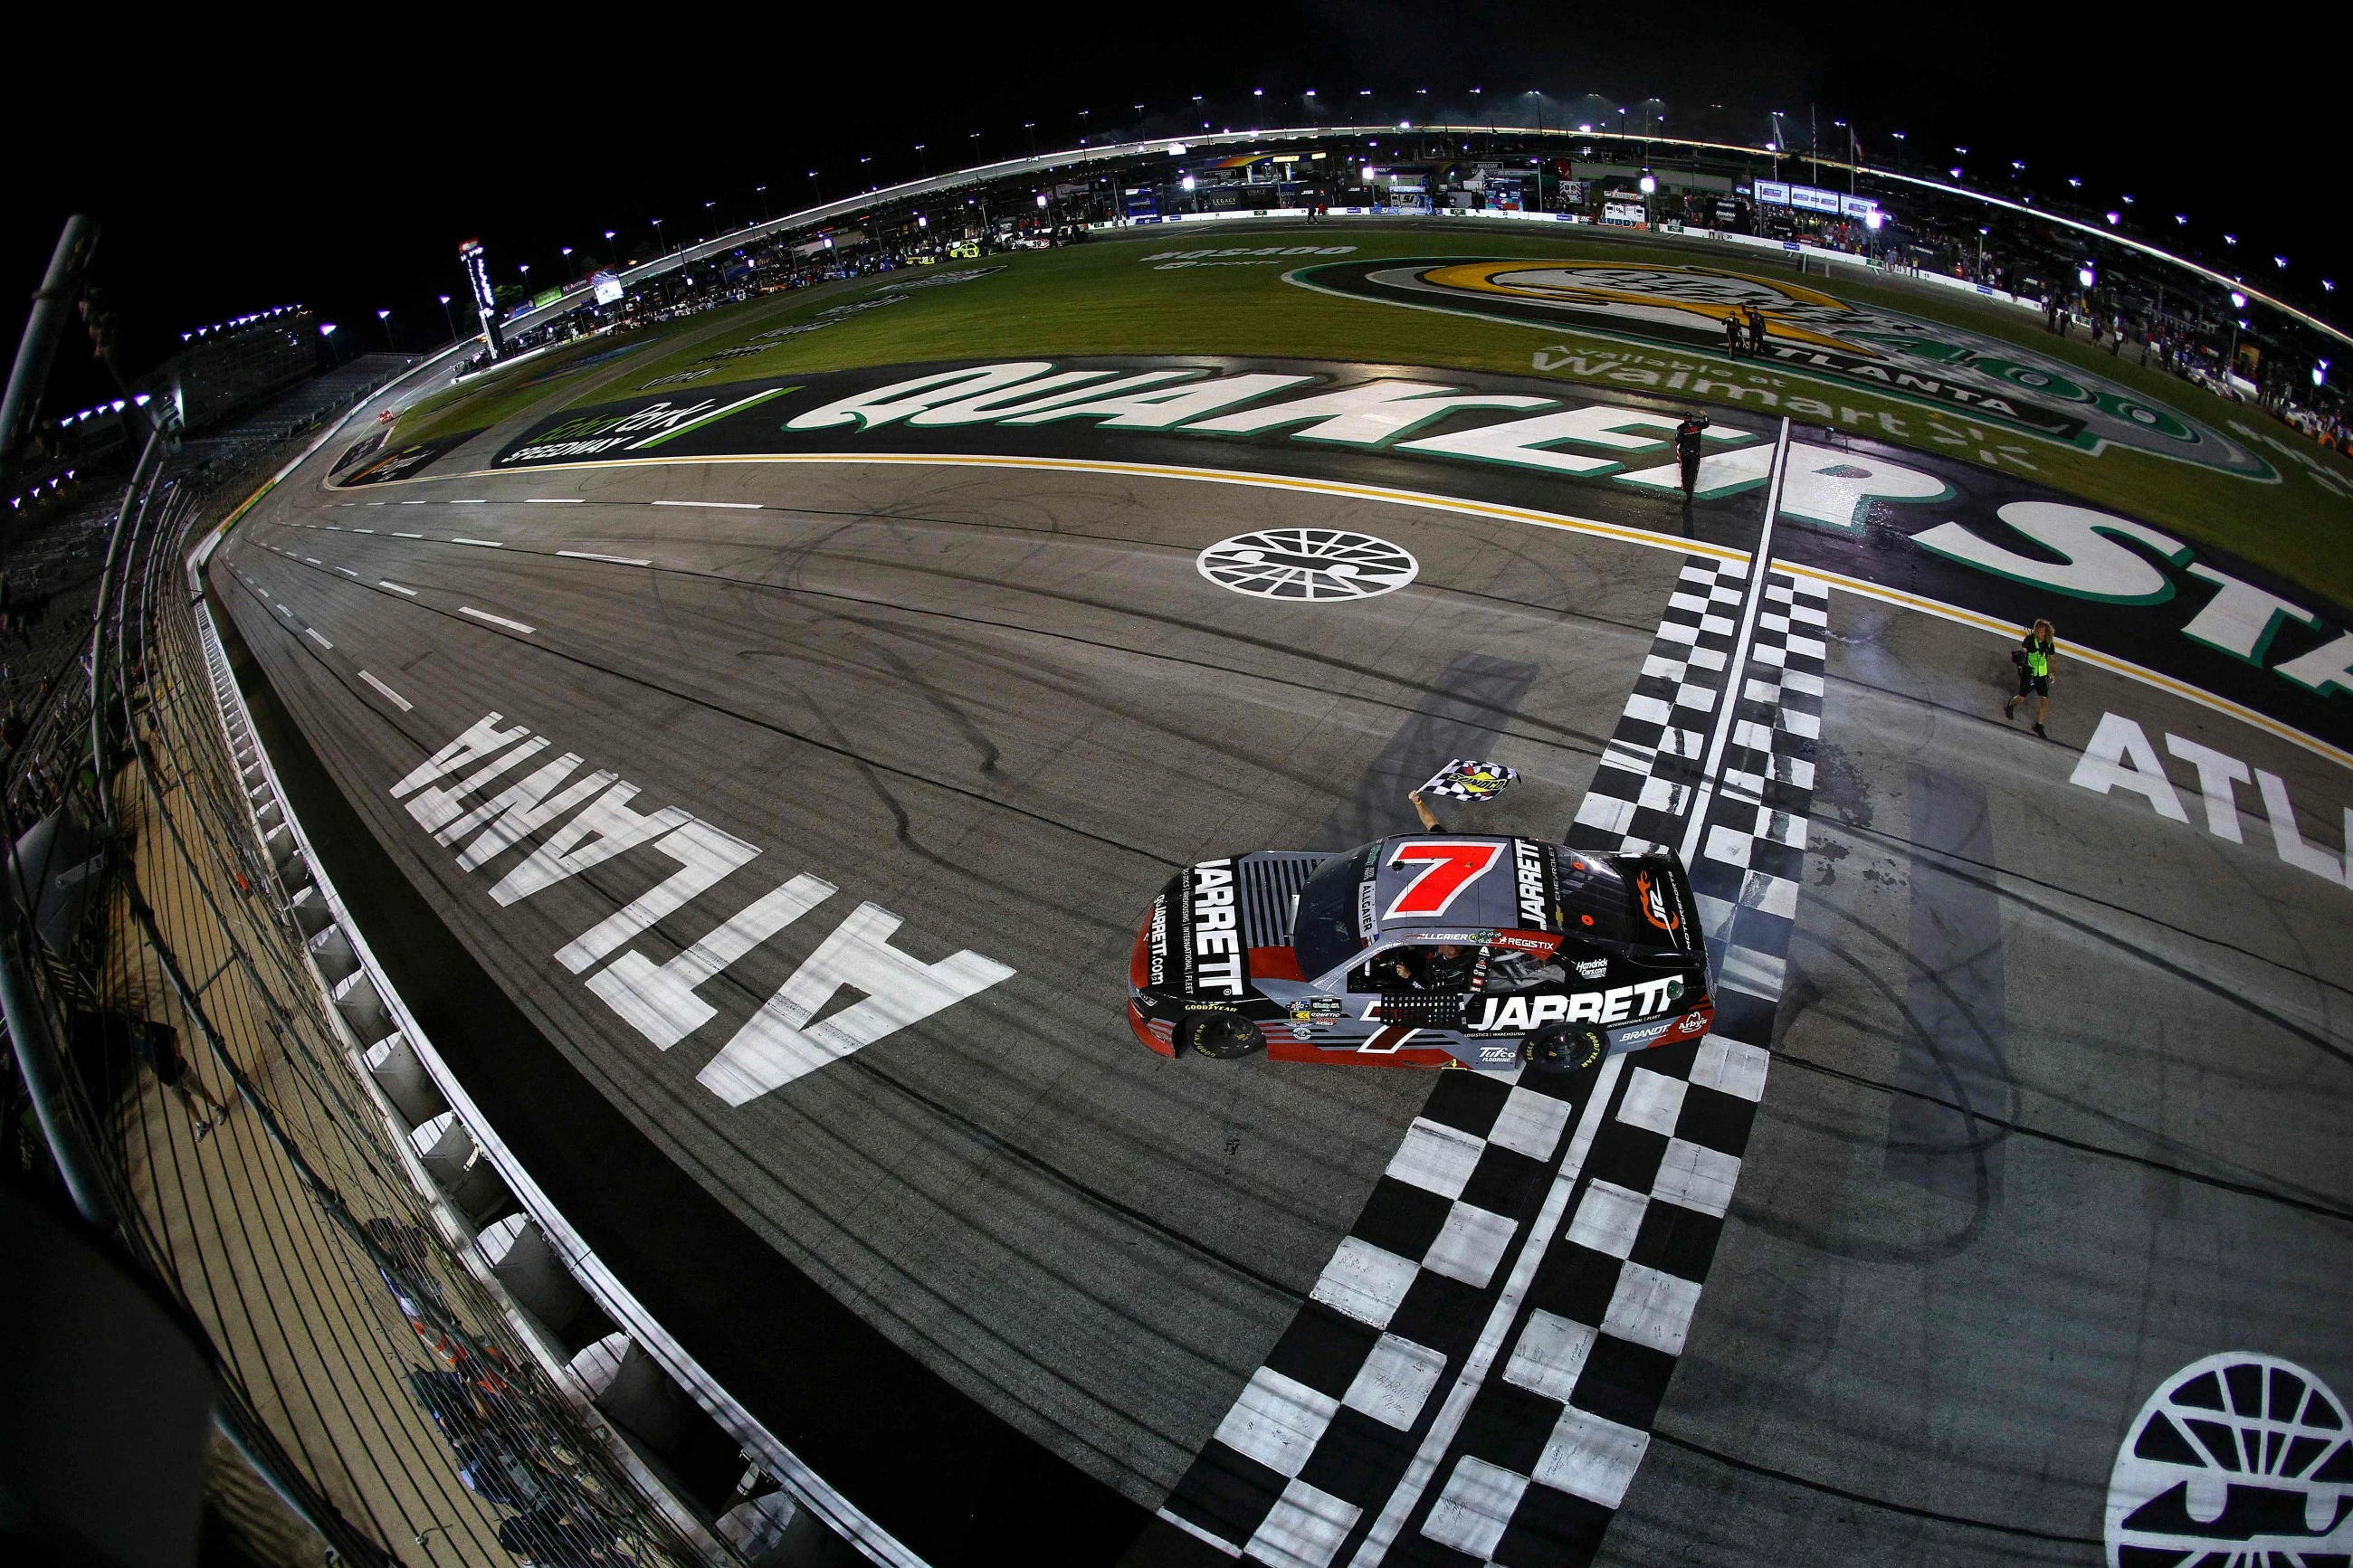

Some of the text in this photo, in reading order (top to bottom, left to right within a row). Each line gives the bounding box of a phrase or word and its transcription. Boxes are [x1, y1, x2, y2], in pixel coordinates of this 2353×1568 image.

[1032, 240, 1042, 248] 39
[1540, 345, 1792, 388] Available at
[1532, 351, 1910, 438] Walmart
[526, 398, 717, 444] EchoPark
[500, 435, 635, 463] SPEEDWAY
[781, 360, 1958, 539] QUAKER
[1447, 772, 1508, 791] SUNOCO
[2069, 711, 2353, 891] ATL
[1381, 841, 1508, 922] 7
[1514, 838, 1548, 931] JARRETT
[1548, 845, 1561, 901] CHEVROLET
[389, 710, 1017, 1108] ATLANTA
[1194, 858, 1244, 996] JARRETT
[1361, 885, 1373, 932] ALLGAIER
[1667, 870, 1692, 950] MOTORSPORTS
[1183, 926, 1193, 971] INTERNATIONAL
[1416, 933, 1469, 941] ALLGAIER
[1507, 938, 1554, 950] REGISTIX
[1576, 958, 1608, 973] Hendrick
[1185, 975, 1194, 995] FLEET
[1467, 974, 1684, 1031] JARRETT
[1185, 1003, 1238, 1013] GOODYEAR
[1606, 1013, 1662, 1029] INTERNATIONAL FLEET
[1678, 1016, 1708, 1030] Arby's
[1194, 1023, 1216, 1059] GOODYEAR
[1526, 1041, 1536, 1060] EAGLE
[1581, 1031, 1601, 1069] GOODYEAR
[1619, 1023, 1672, 1042] BRANDT
[1479, 1046, 1517, 1058] Tufco
